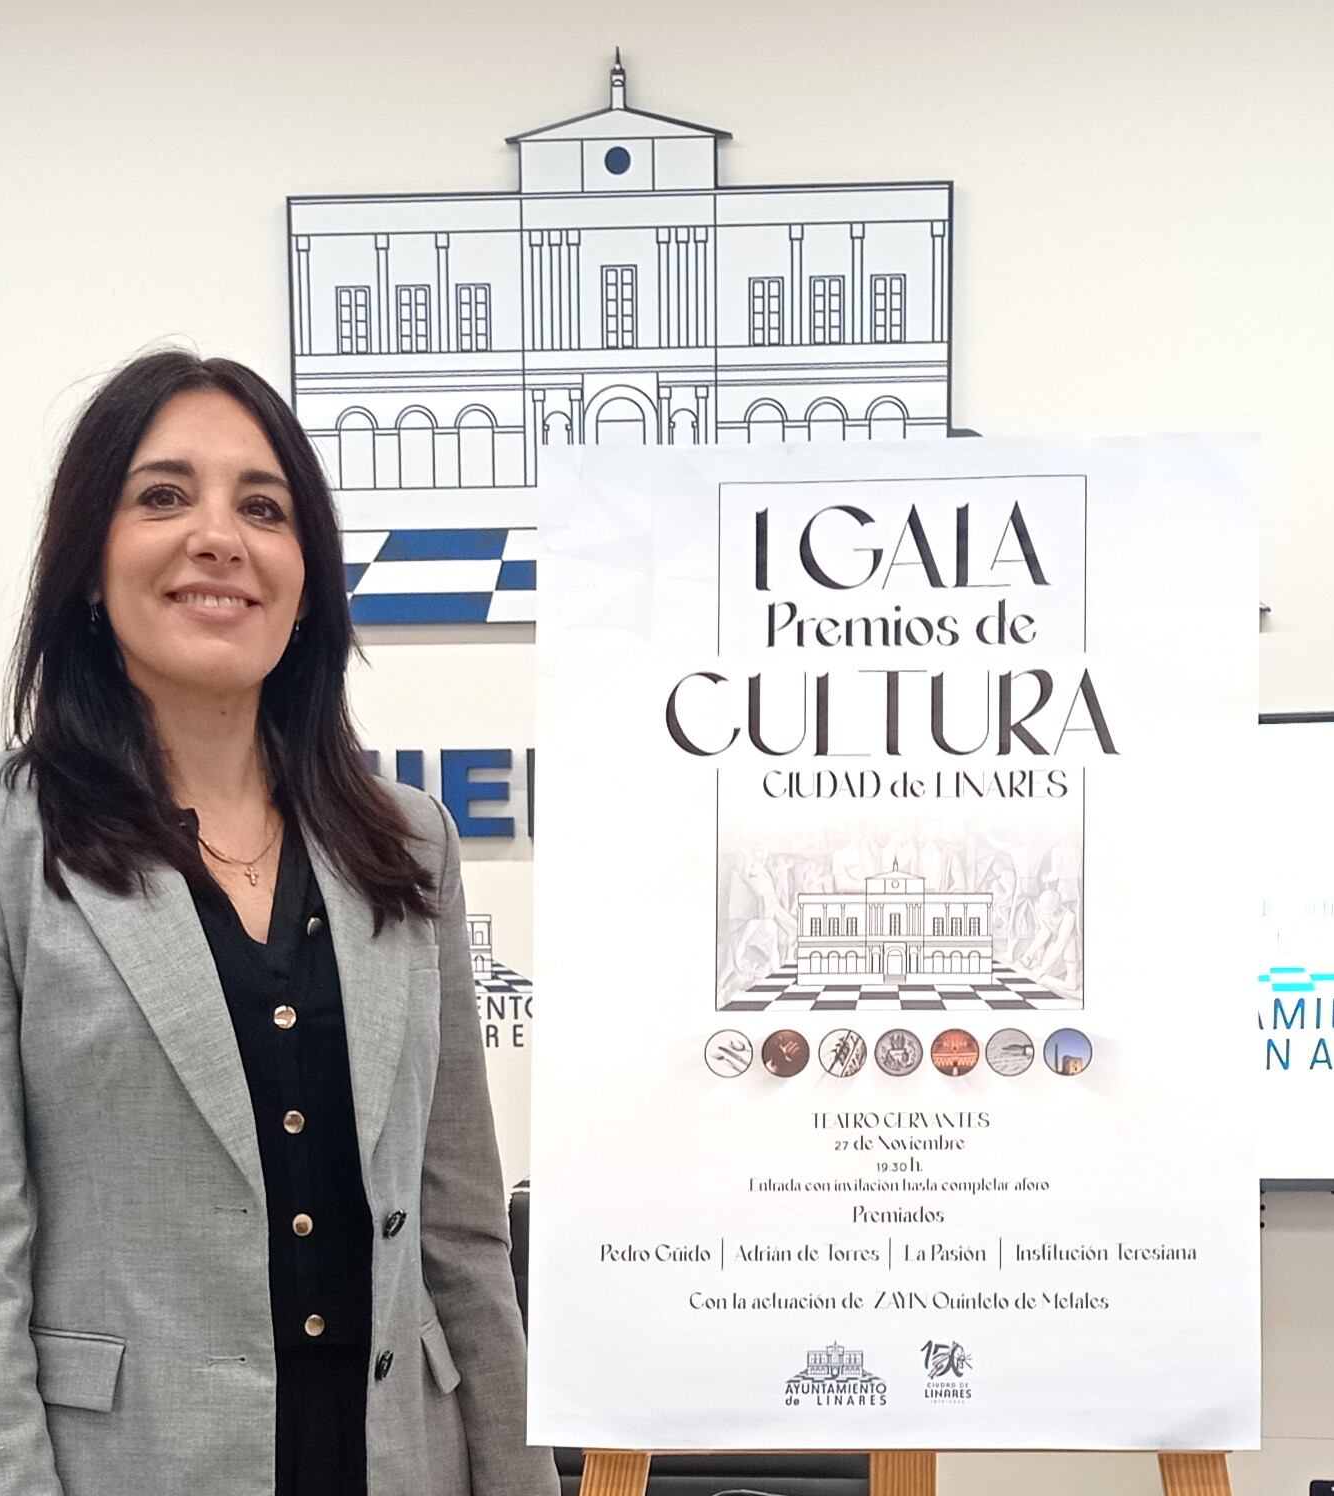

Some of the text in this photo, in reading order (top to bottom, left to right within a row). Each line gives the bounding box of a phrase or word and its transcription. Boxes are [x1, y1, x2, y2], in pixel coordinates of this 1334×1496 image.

[754, 500, 1052, 592] I GALA
[767, 598, 1037, 649] Premios de
[665, 667, 1122, 757] CULTURA
[762, 769, 1069, 799] CIUDAD de LINARES
[812, 1111, 991, 1129] TEATRO CERVANTES
[834, 1134, 966, 1151] 27 de Noviembre
[749, 1176, 1050, 1196] Entrada con invitación hasta completar aforo
[852, 1205, 945, 1224] Premiados
[600, 1244, 650, 1262] Pedro
[735, 1243, 880, 1262] Adrián de Torres
[904, 1243, 987, 1262] La Pasión
[1016, 1242, 1197, 1262] Institución Teresiana
[689, 1291, 727, 1310] Con
[733, 1291, 747, 1310] la
[751, 1291, 836, 1310] actuación
[841, 1291, 864, 1310] de
[932, 1291, 1010, 1310] Quinteto
[1014, 1291, 1038, 1310] de
[1041, 1291, 1110, 1310] Metales
[785, 1382, 887, 1395] AYUNTAMIENTO
[924, 1388, 972, 1399] LINARES
[785, 1394, 887, 1406] de LINARES
